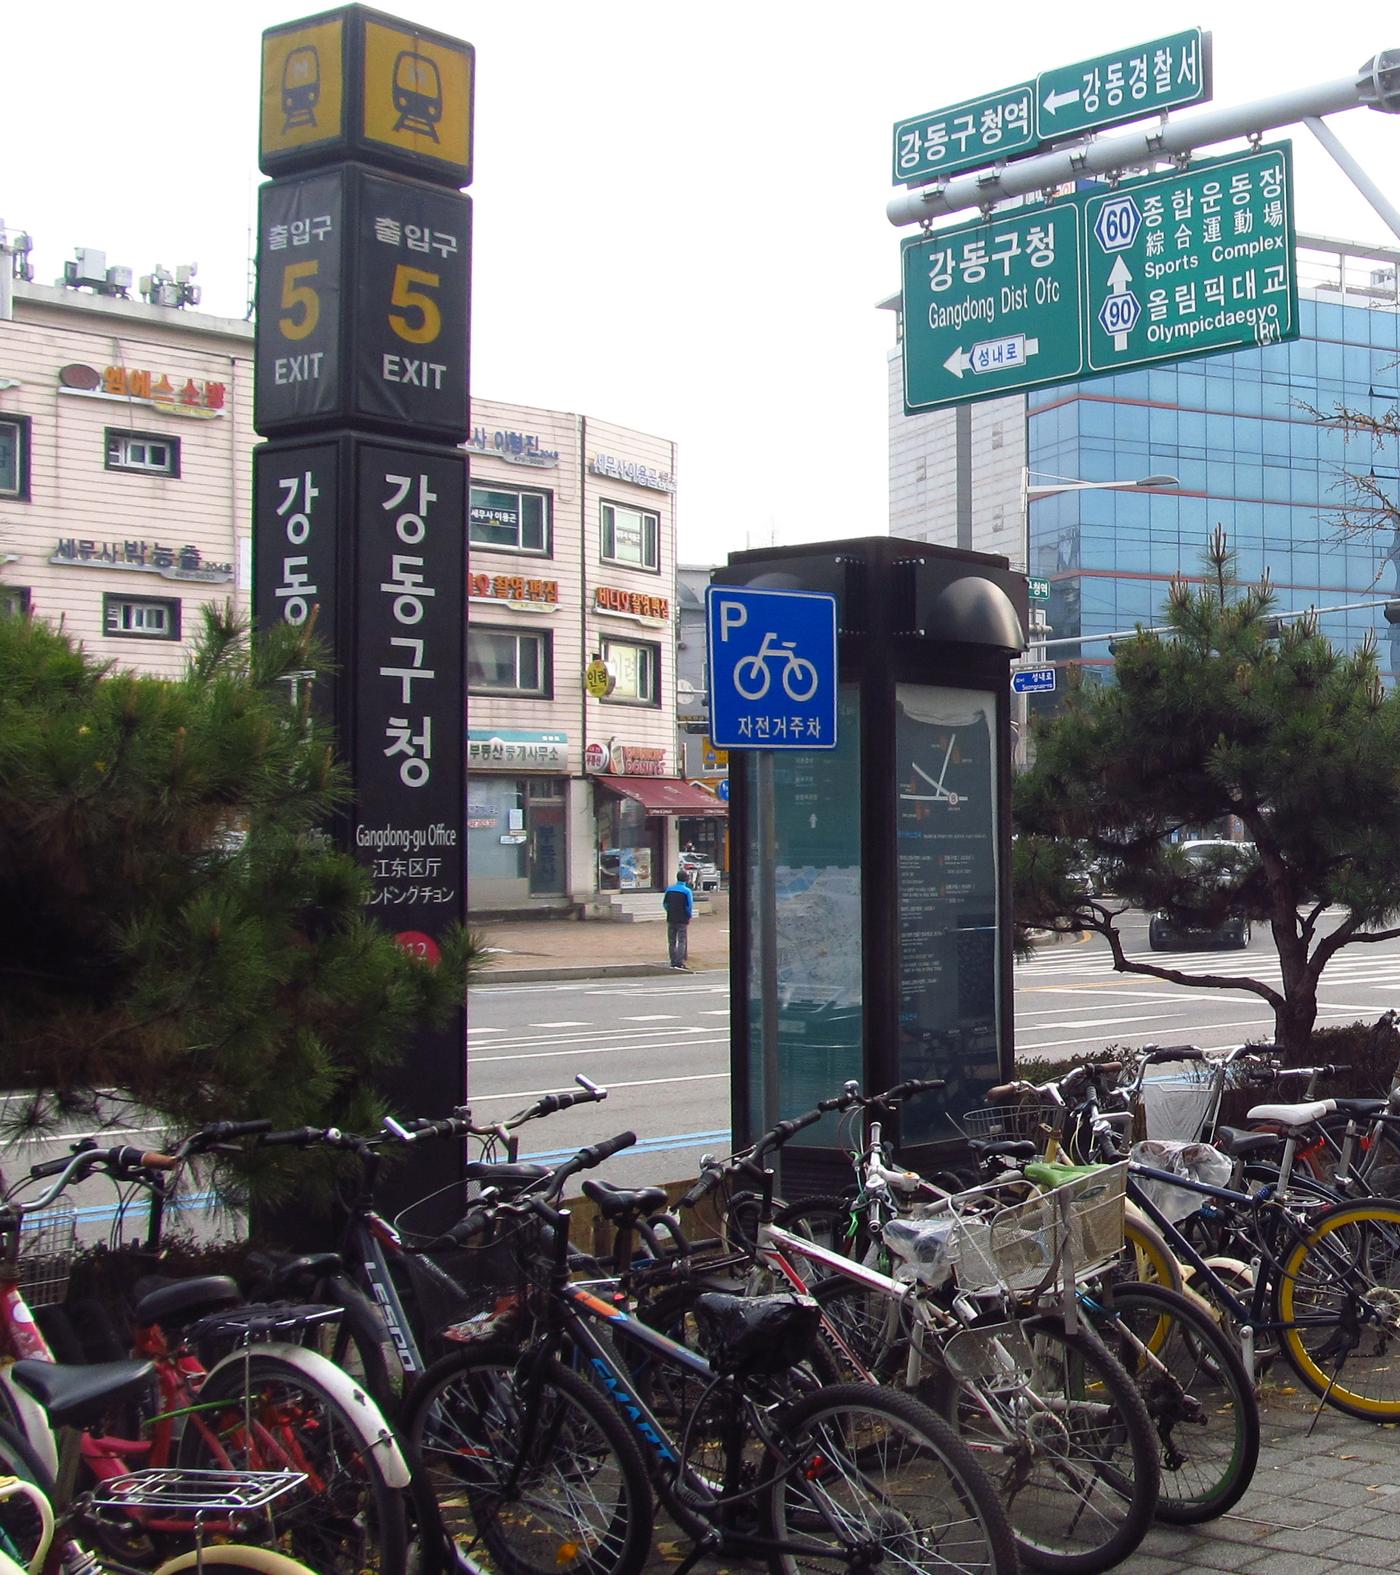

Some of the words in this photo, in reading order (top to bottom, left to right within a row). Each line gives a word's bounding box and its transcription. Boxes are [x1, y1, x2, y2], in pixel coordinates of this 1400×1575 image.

[1083, 40, 1197, 113] 강동경찰서
[900, 98, 1028, 169] 강동구청역
[1143, 166, 1283, 228] 종합운동장
[268, 215, 333, 251] 출입구
[374, 215, 457, 258] 출입구
[1105, 206, 1131, 241] 60
[929, 223, 1055, 292] 강동구청
[1145, 255, 1199, 279] Sports
[1212, 233, 1284, 263] Complex
[278, 259, 320, 341] 5
[388, 264, 442, 344] 5
[928, 294, 995, 331] Gangdong
[1001, 286, 1028, 316] Dist
[1035, 277, 1060, 305] Ofc
[1146, 264, 1287, 322] 올림픽대교
[1109, 301, 1131, 326] 90
[1147, 303, 1278, 343] Olympicdaegyo
[1253, 318, 1281, 346] (Br)
[274, 352, 324, 386] EXIT
[382, 354, 447, 391] EXIT
[977, 343, 1019, 368] 성내로
[1029, 582, 1048, 596] 청역
[379, 473, 437, 788] 강동구청
[720, 601, 747, 642] P
[587, 669, 607, 687] 인력
[738, 716, 822, 739] 자전거주차
[356, 824, 426, 852] Gangdong-gu
[428, 823, 457, 846] Office
[372, 858, 442, 878] 江东区厅
